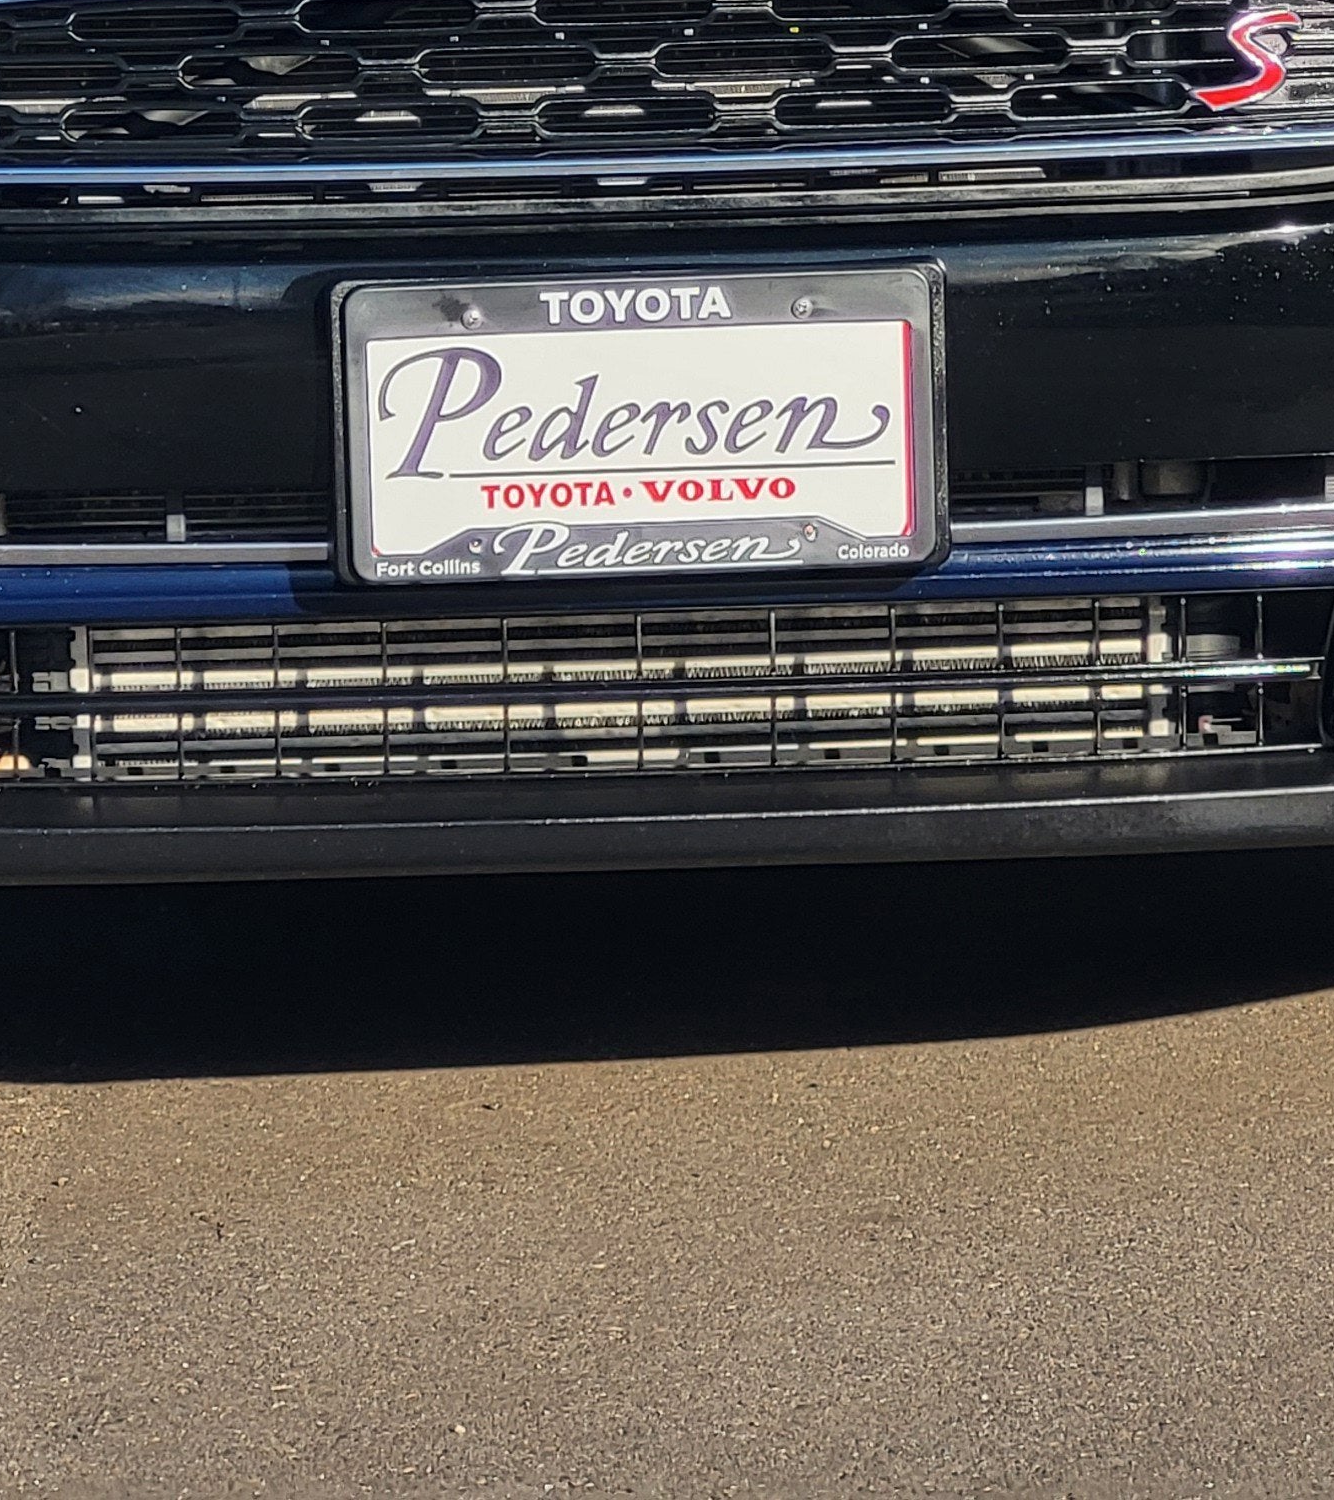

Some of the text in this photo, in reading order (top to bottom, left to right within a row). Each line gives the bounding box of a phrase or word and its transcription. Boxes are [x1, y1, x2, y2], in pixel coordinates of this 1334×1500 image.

[1191, 8, 1303, 113] S
[539, 285, 733, 325] TOYOTA
[378, 346, 891, 480] Pedersen
[480, 477, 797, 509] TOYOTA VOLVO
[375, 558, 482, 578] Fort Collins
[493, 522, 802, 576] Pedersen
[837, 542, 910, 561] Colorado
